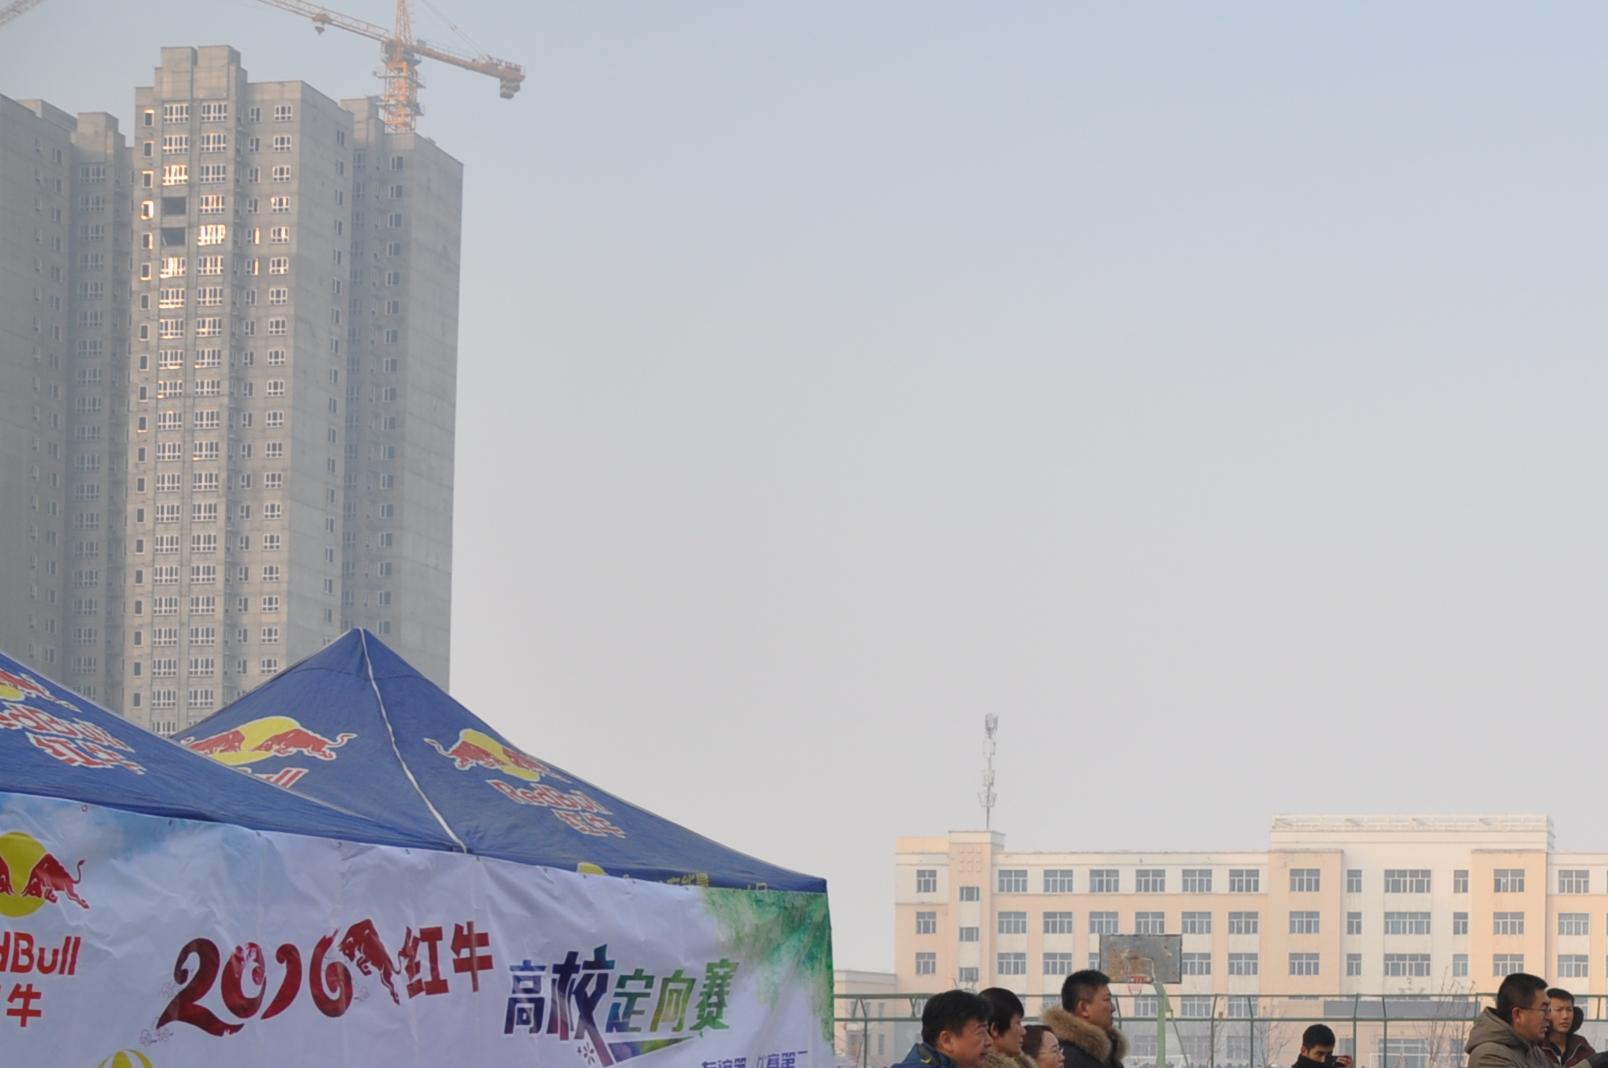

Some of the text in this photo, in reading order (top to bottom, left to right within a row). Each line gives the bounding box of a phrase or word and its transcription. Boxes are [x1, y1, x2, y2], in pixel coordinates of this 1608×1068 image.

[485, 779, 614, 815] RedBull
[402, 921, 494, 999] 红牛
[0, 983, 42, 1028] 牛
[504, 944, 740, 1066] 高校定向赛
